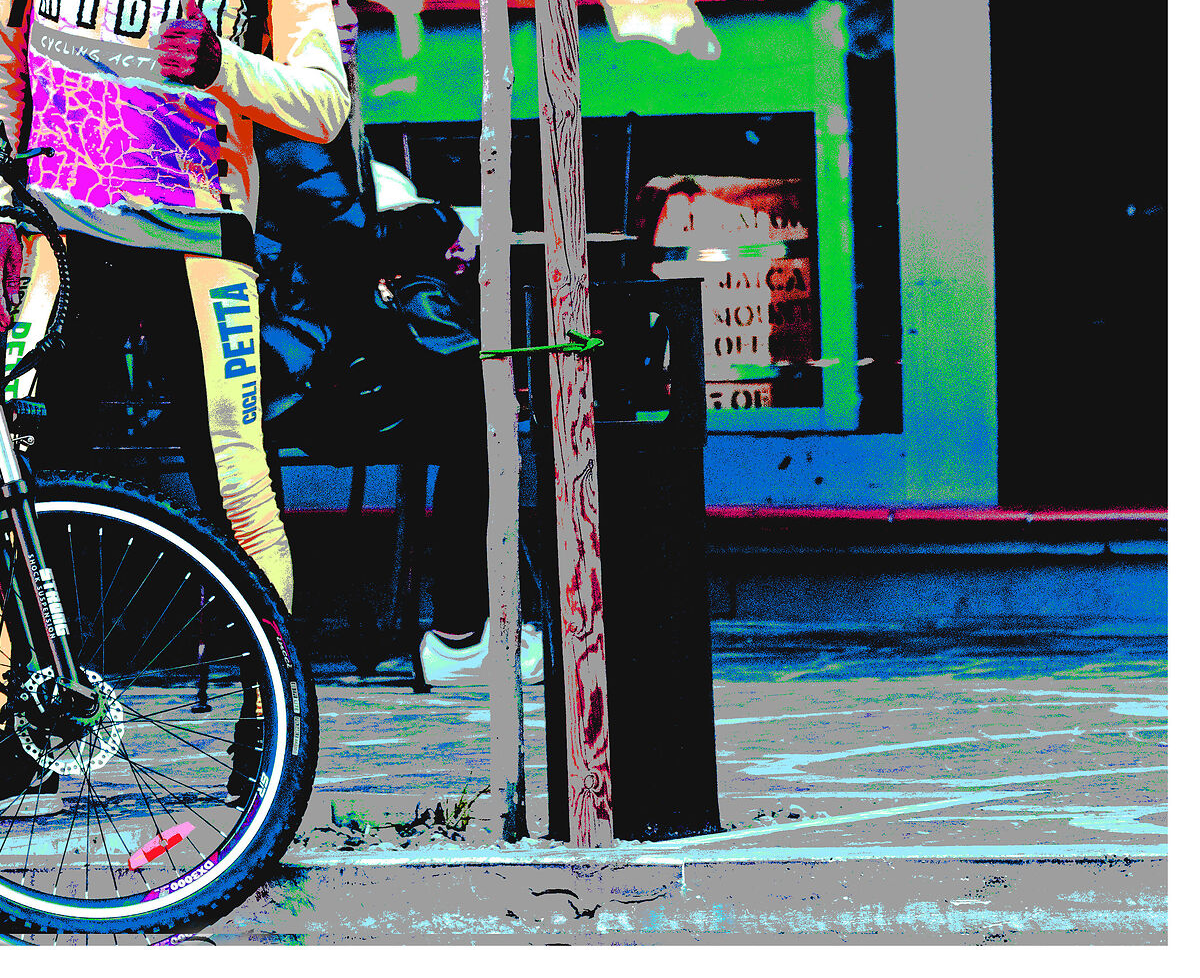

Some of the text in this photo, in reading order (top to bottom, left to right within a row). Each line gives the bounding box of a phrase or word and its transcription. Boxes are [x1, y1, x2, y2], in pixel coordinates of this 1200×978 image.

[40, 35, 100, 62] CYCLING
[209, 282, 257, 425] CICLI PETTA
[28, 553, 57, 640] SHOCK SUSPENSION
[170, 859, 215, 891] DX3000
